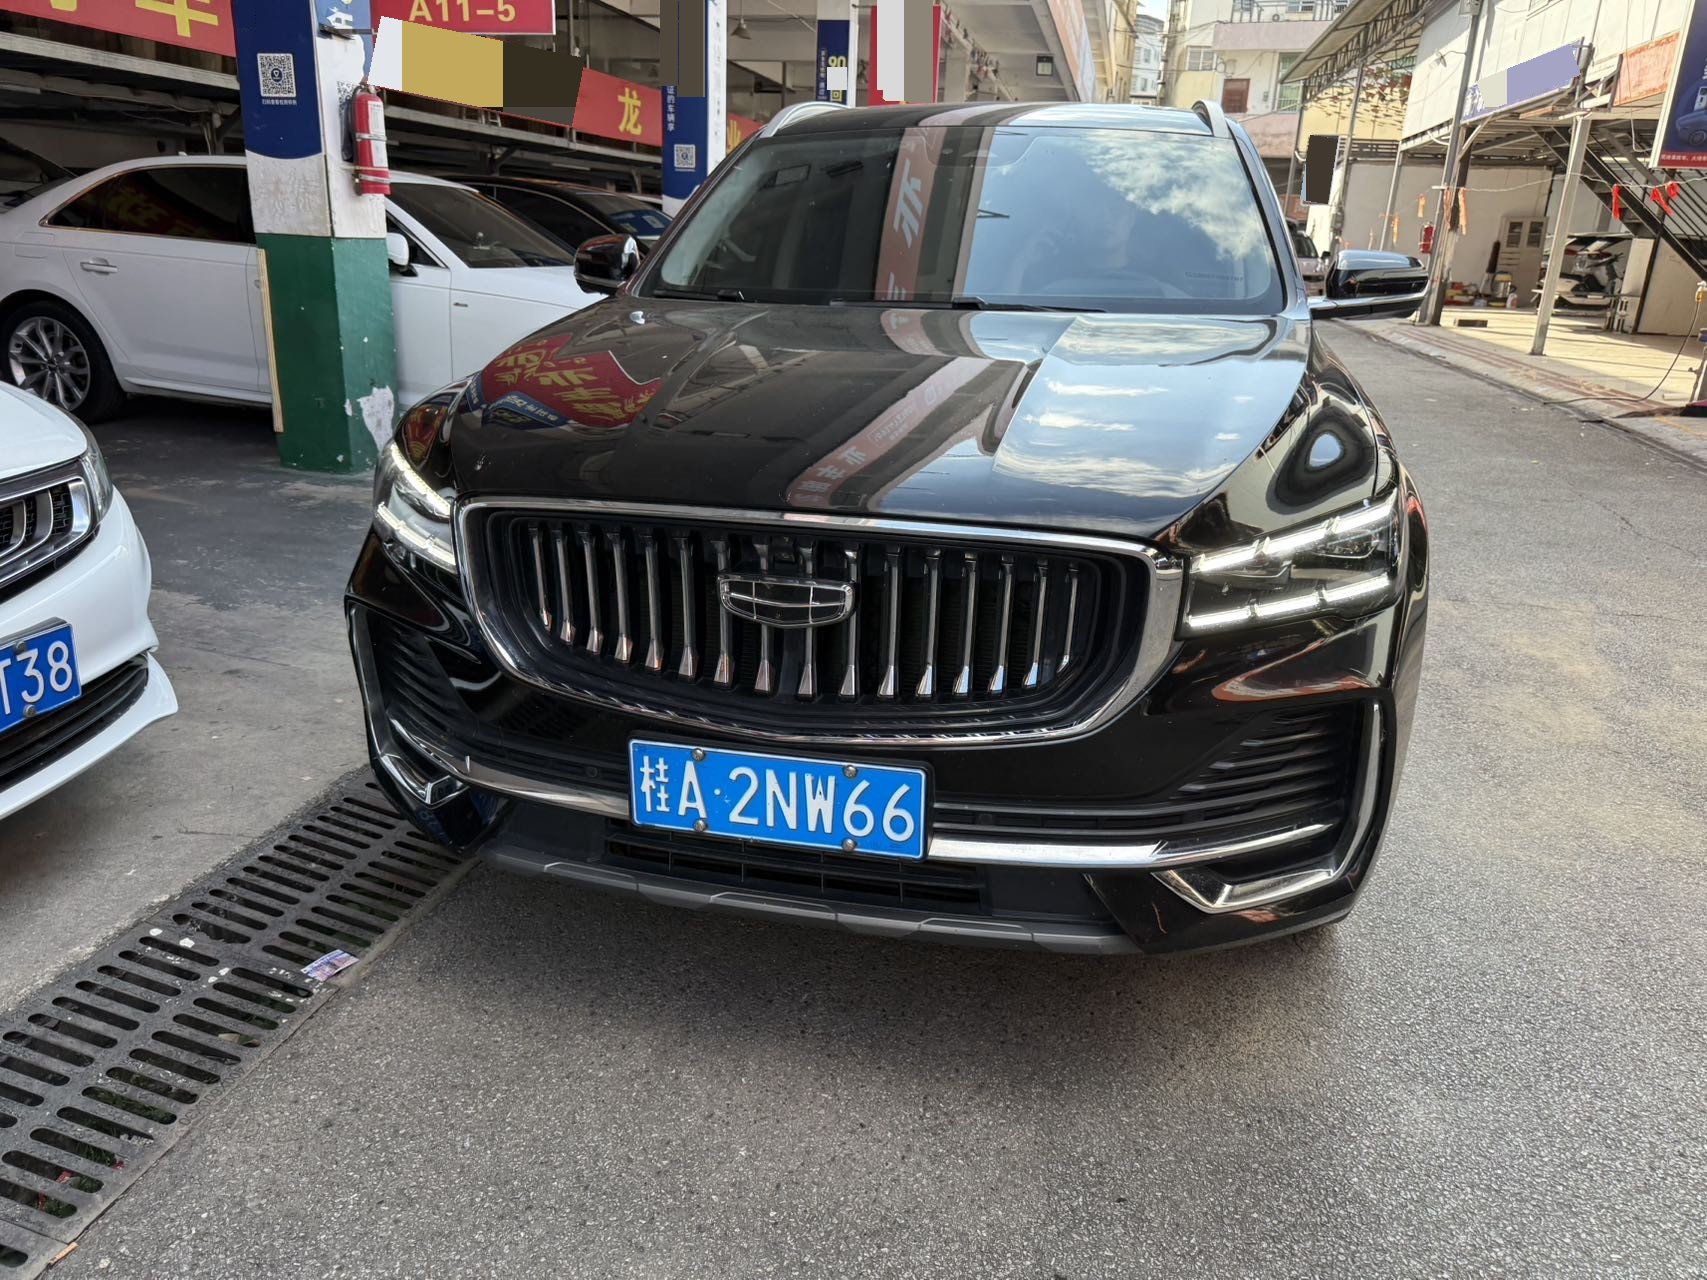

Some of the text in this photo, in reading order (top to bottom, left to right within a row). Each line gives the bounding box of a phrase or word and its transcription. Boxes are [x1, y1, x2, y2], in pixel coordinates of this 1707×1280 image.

[617, 87, 643, 136] 龙
[0, 640, 73, 715] T38
[640, 755, 915, 842] 桂A·2NW66
